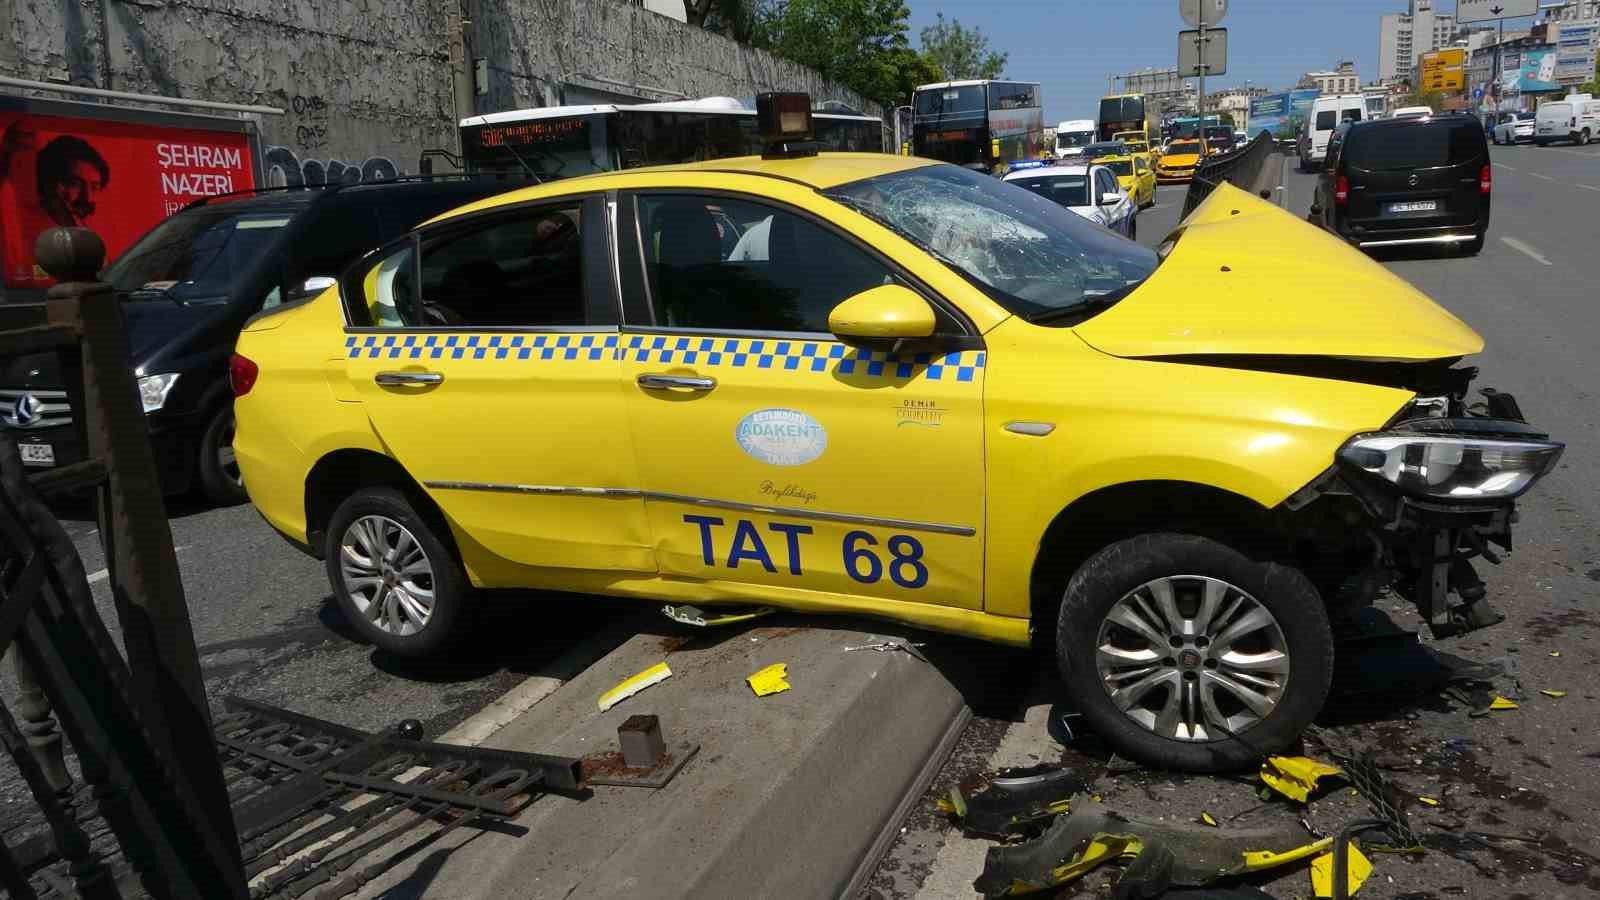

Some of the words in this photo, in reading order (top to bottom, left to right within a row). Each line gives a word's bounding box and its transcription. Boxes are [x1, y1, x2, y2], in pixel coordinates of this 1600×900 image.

[157, 143, 242, 170] ŞEHRAM
[161, 171, 234, 196] NAZERİ
[742, 422, 820, 438] ADAKENT
[683, 514, 814, 576] TAT
[842, 530, 929, 589] 68
